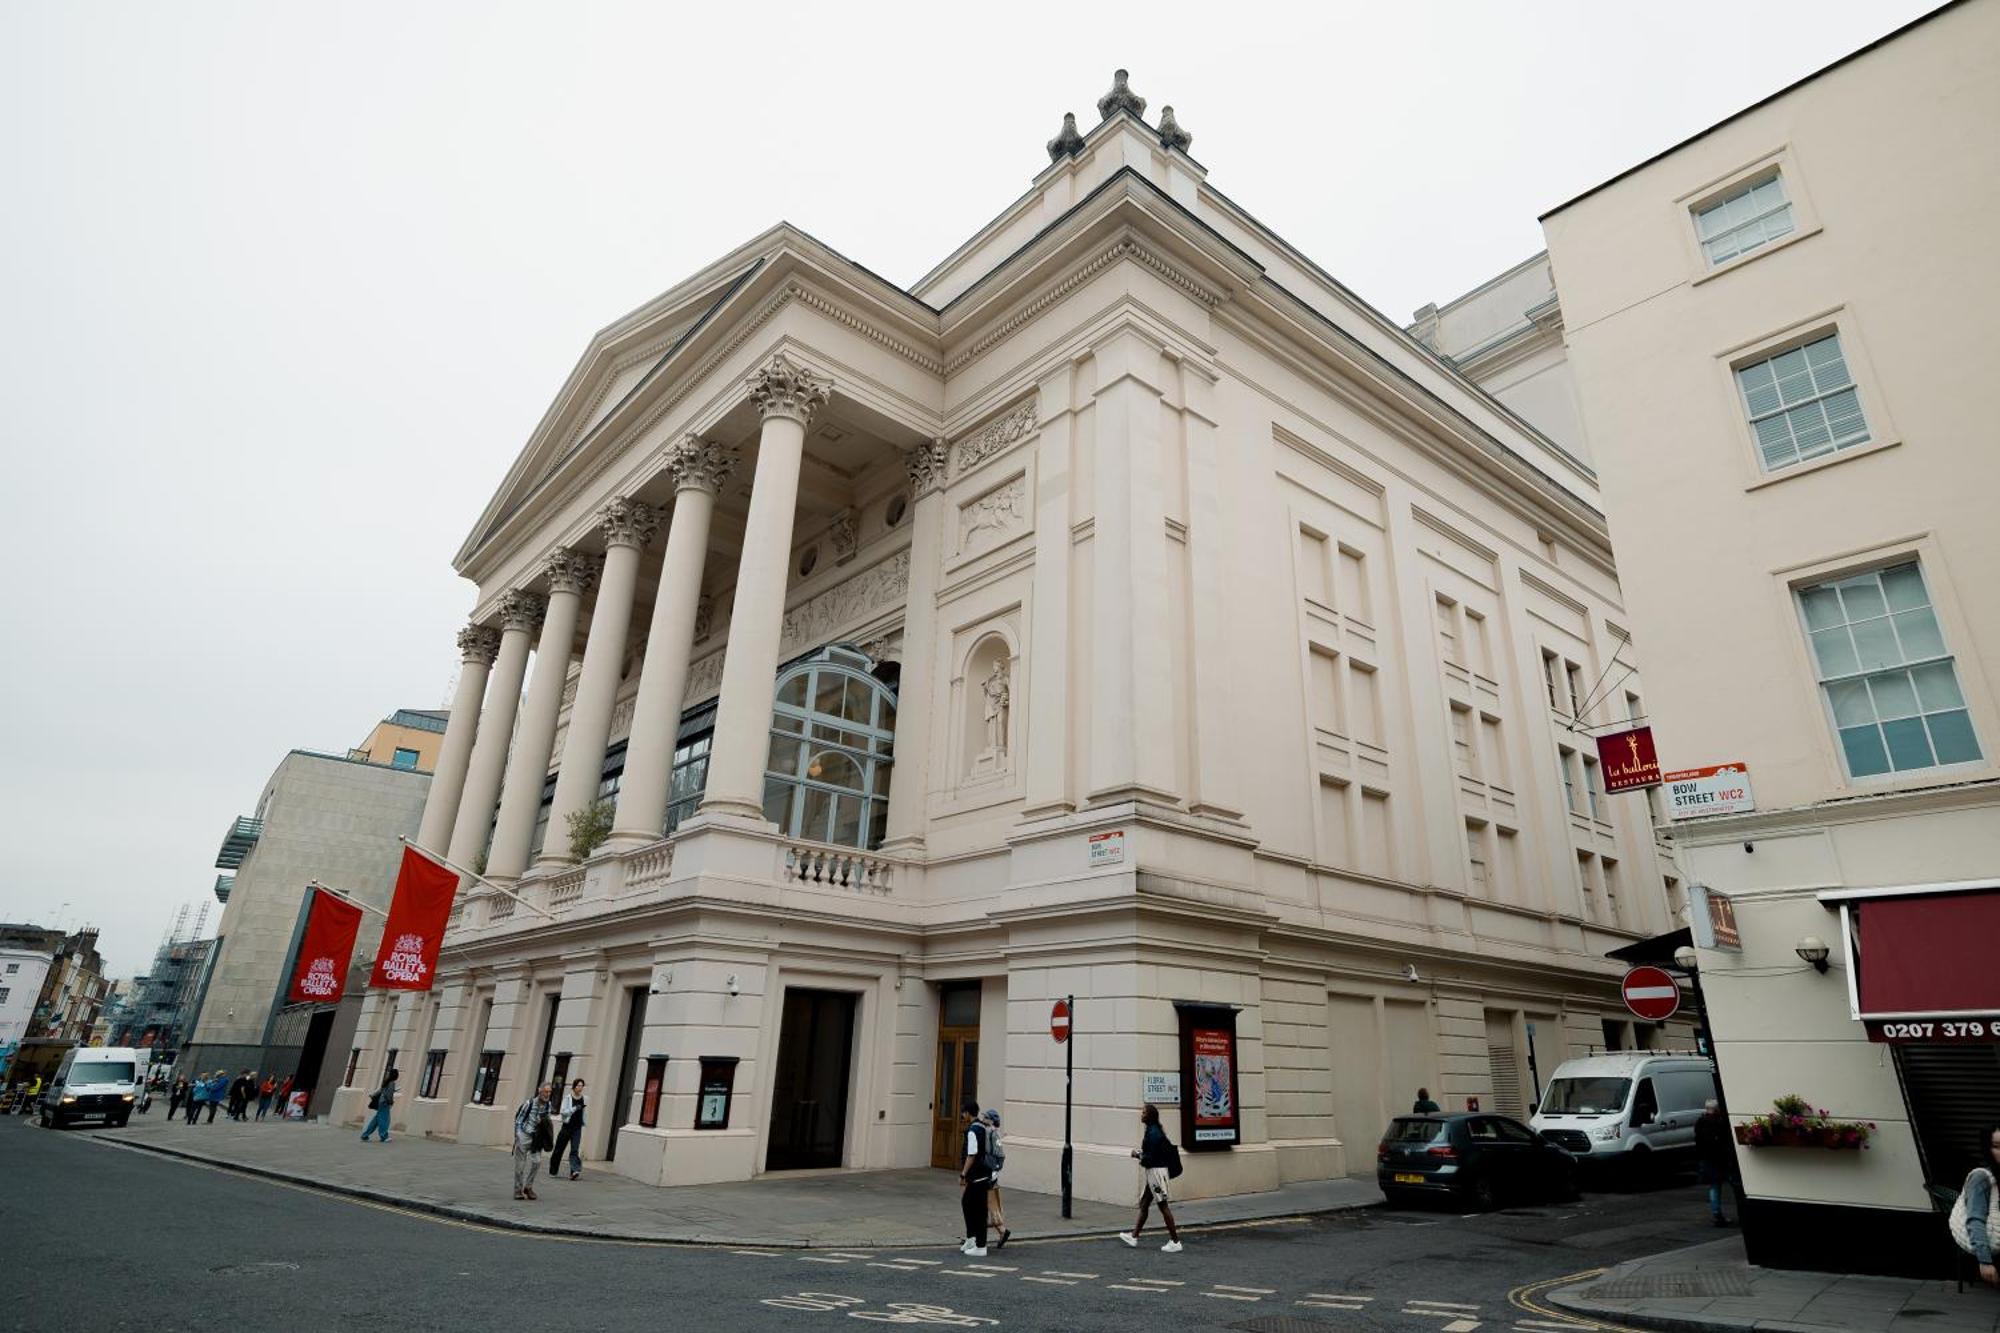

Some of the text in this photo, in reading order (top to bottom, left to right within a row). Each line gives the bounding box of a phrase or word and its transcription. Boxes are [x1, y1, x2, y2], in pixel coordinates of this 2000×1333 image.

[1673, 782, 1697, 795] BOW
[1675, 788, 1744, 806] STREET WC2
[391, 952, 423, 964] ROYAL
[382, 960, 427, 973] BALLET &
[308, 972, 334, 981] ROYAL
[386, 970, 420, 982] OPERA
[301, 978, 329, 988] BALLET
[303, 986, 332, 995] OPERA
[1883, 1023, 1935, 1038] 0207
[1941, 1022, 1984, 1037] 379
[1147, 1084, 1167, 1093] STREET
